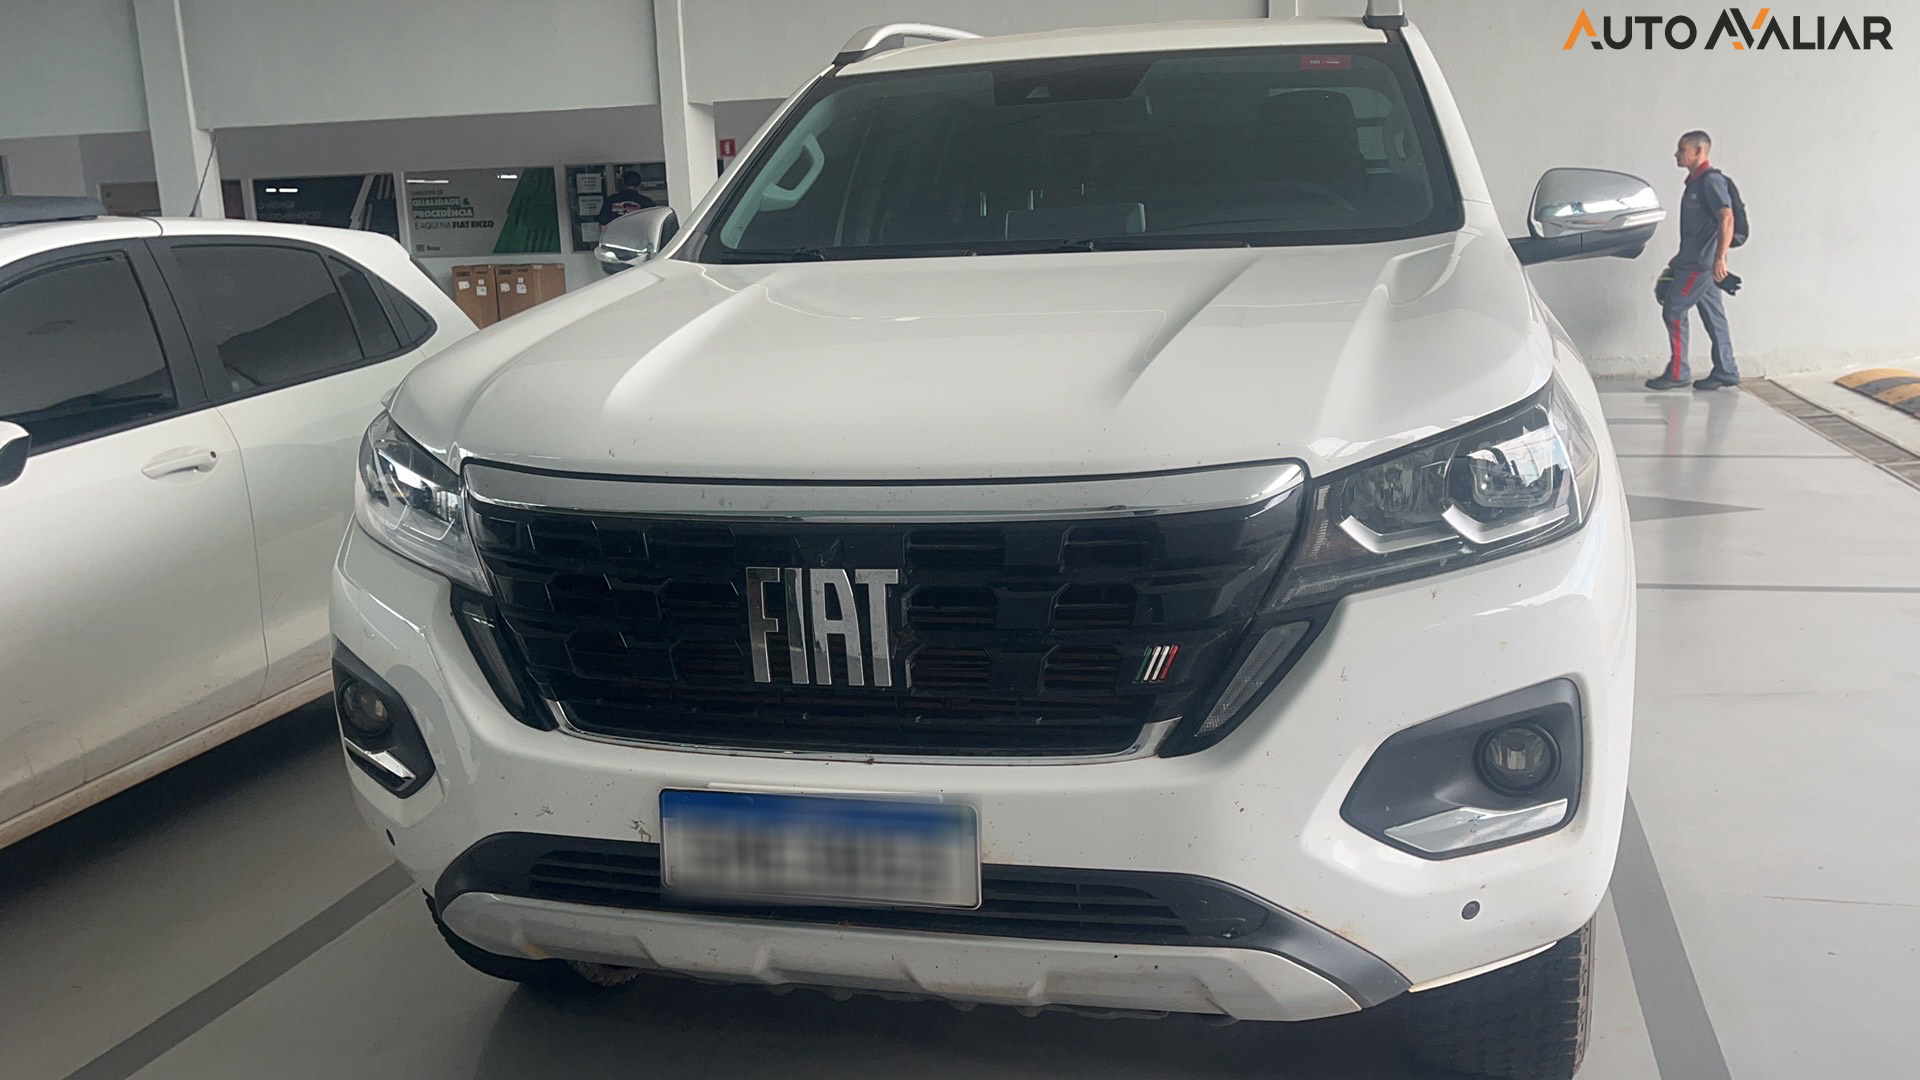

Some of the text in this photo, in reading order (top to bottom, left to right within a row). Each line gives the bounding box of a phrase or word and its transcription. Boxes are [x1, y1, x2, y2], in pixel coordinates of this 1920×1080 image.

[412, 198, 460, 206] QUALIDADE
[413, 208, 473, 218] PROCEDÊNCIA
[420, 221, 438, 230] AQUI
[452, 220, 470, 229] FIAT
[471, 220, 494, 228] ENZO
[746, 567, 898, 687] FIAT
